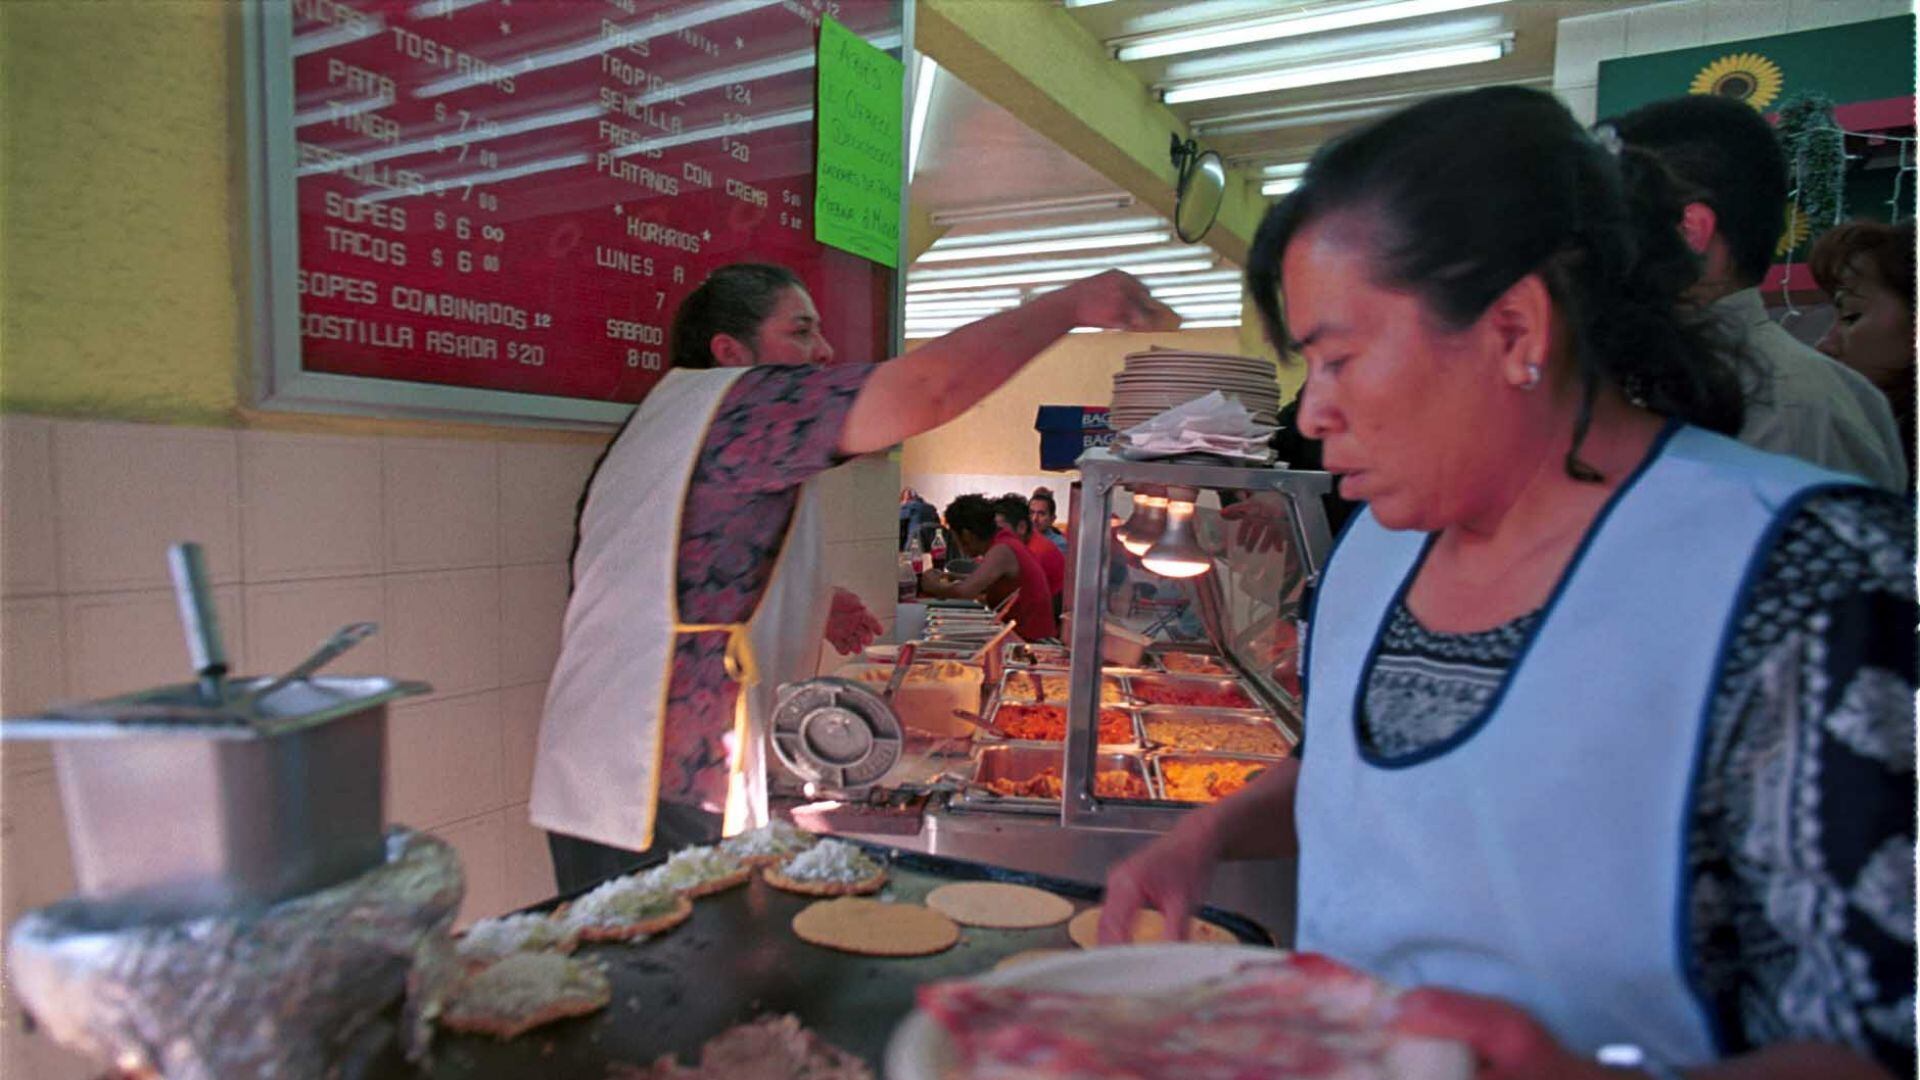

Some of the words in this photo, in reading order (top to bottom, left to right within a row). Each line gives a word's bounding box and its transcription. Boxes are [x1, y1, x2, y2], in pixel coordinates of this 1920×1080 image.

[328, 58, 396, 105] PATA
[327, 101, 400, 142] TINGA
[600, 86, 682, 134] SENCILLA
[597, 152, 679, 197] PLATANOS
[683, 162, 712, 189] CON
[726, 179, 768, 208] CREMA
[325, 191, 407, 232] SOPES
[456, 216, 471, 240] 6
[324, 226, 407, 266] TACOS
[457, 250, 473, 273] 6
[596, 246, 654, 277] LUNES
[673, 266, 684, 284] A
[298, 269, 378, 305] SOPES
[392, 286, 528, 330] COMBINADOS
[425, 331, 498, 360] ASADA
[507, 342, 545, 366] $20
[606, 319, 663, 346] SABADO
